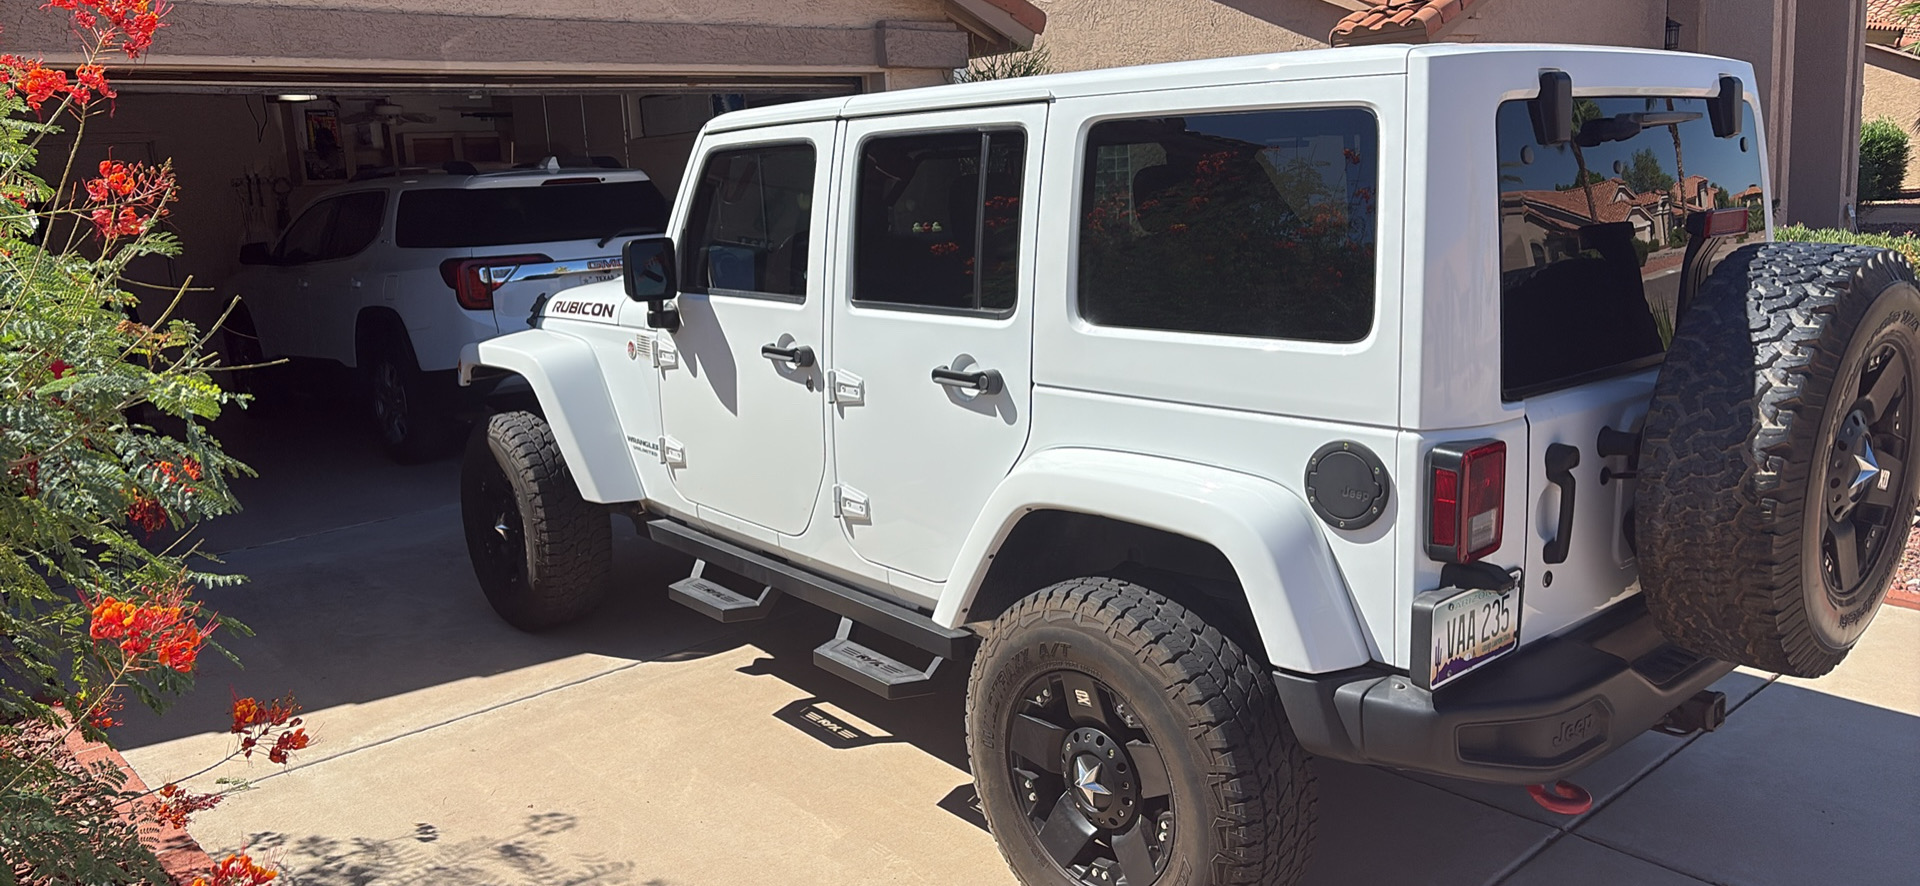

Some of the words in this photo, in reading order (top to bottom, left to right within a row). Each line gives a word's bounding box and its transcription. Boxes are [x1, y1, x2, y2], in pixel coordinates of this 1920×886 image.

[552, 301, 616, 318] RUBICON
[1341, 485, 1370, 502] Jeep
[1446, 609, 1476, 659] VAA
[1481, 594, 1510, 643] 235
[1039, 641, 1072, 659] A/T
[1552, 713, 1593, 747] Jeep
